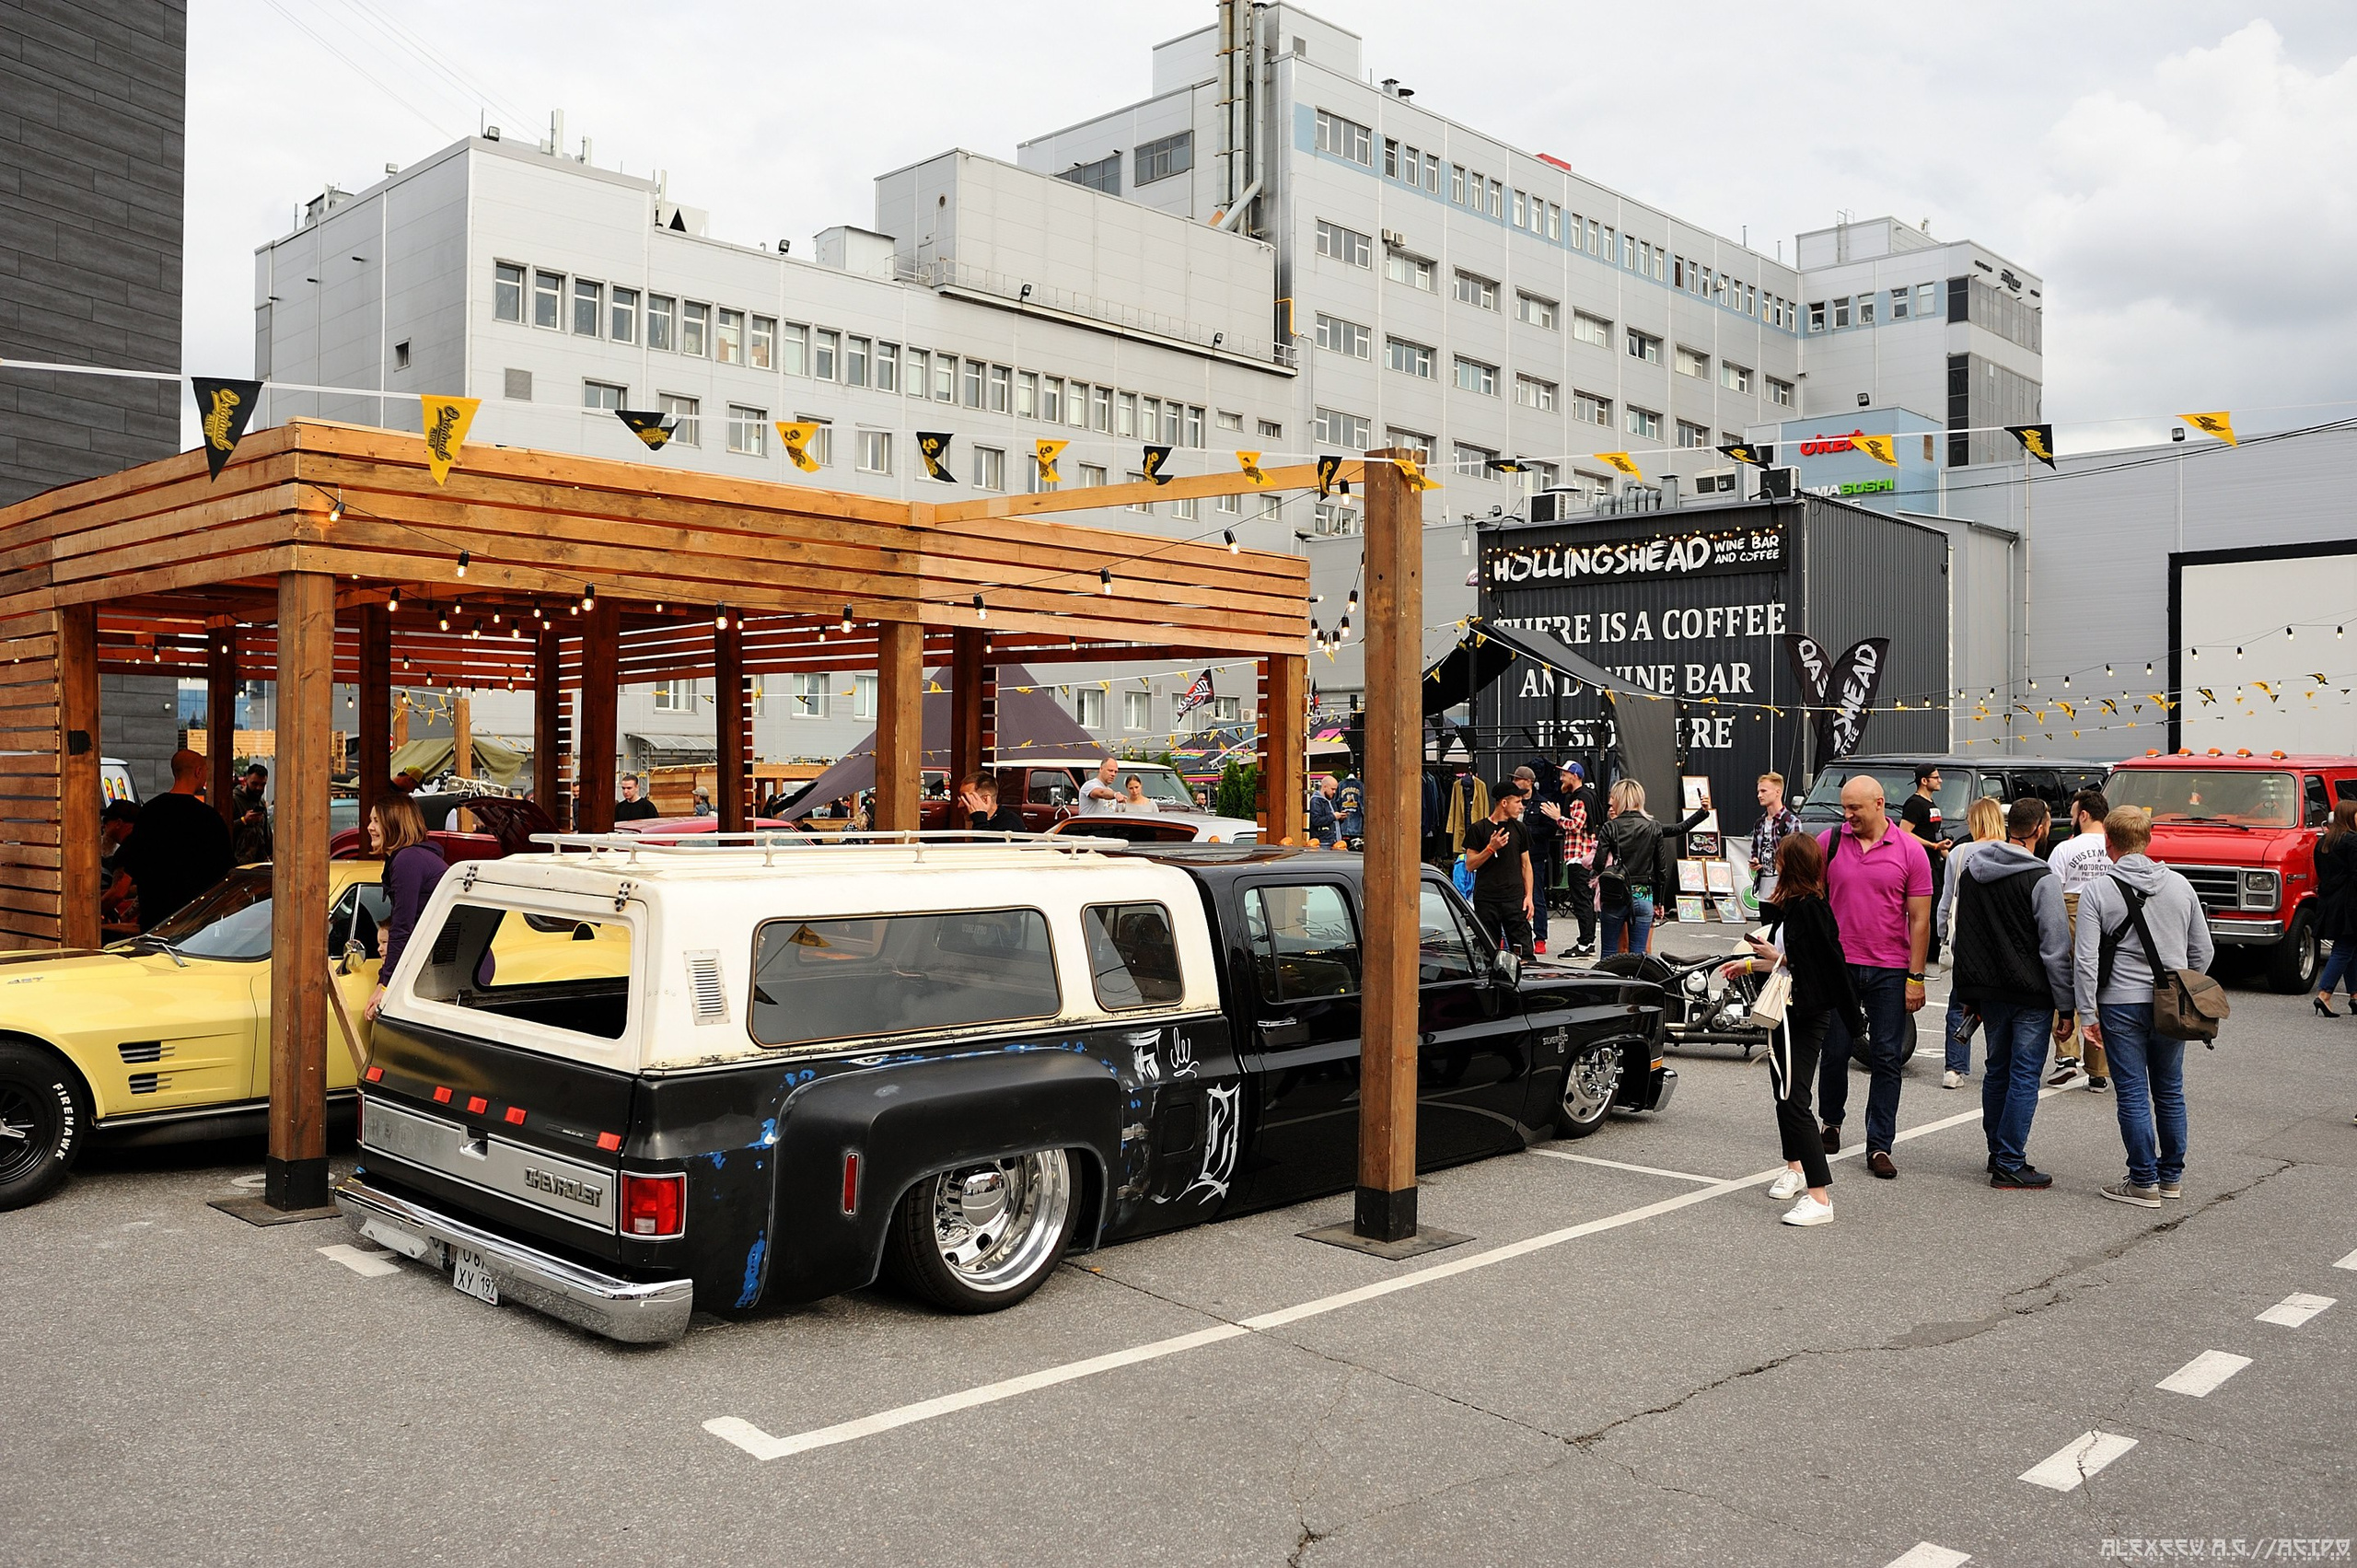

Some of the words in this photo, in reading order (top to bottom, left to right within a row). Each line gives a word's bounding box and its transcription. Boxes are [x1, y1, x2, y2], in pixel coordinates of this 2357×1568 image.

[210, 388, 241, 451] Original
[435, 405, 461, 461] Original
[1493, 537, 1711, 582] HOLLINGSHEAD
[1713, 537, 1746, 553] WINE
[1751, 534, 1781, 550] BAR
[1713, 552, 1737, 564] AND
[1739, 548, 1781, 563] COFFEE
[1598, 611, 1627, 643] IS
[1631, 610, 1655, 642] A
[1661, 603, 1787, 641] COFFEE
[1685, 662, 1754, 694] BAR
[1839, 726, 1860, 757] FFEE
[2069, 852, 2087, 869] DEUS
[2086, 849, 2096, 858] EX
[52, 1082, 75, 1161] FIREHAWK
[524, 1166, 603, 1208] CHEVROLET
